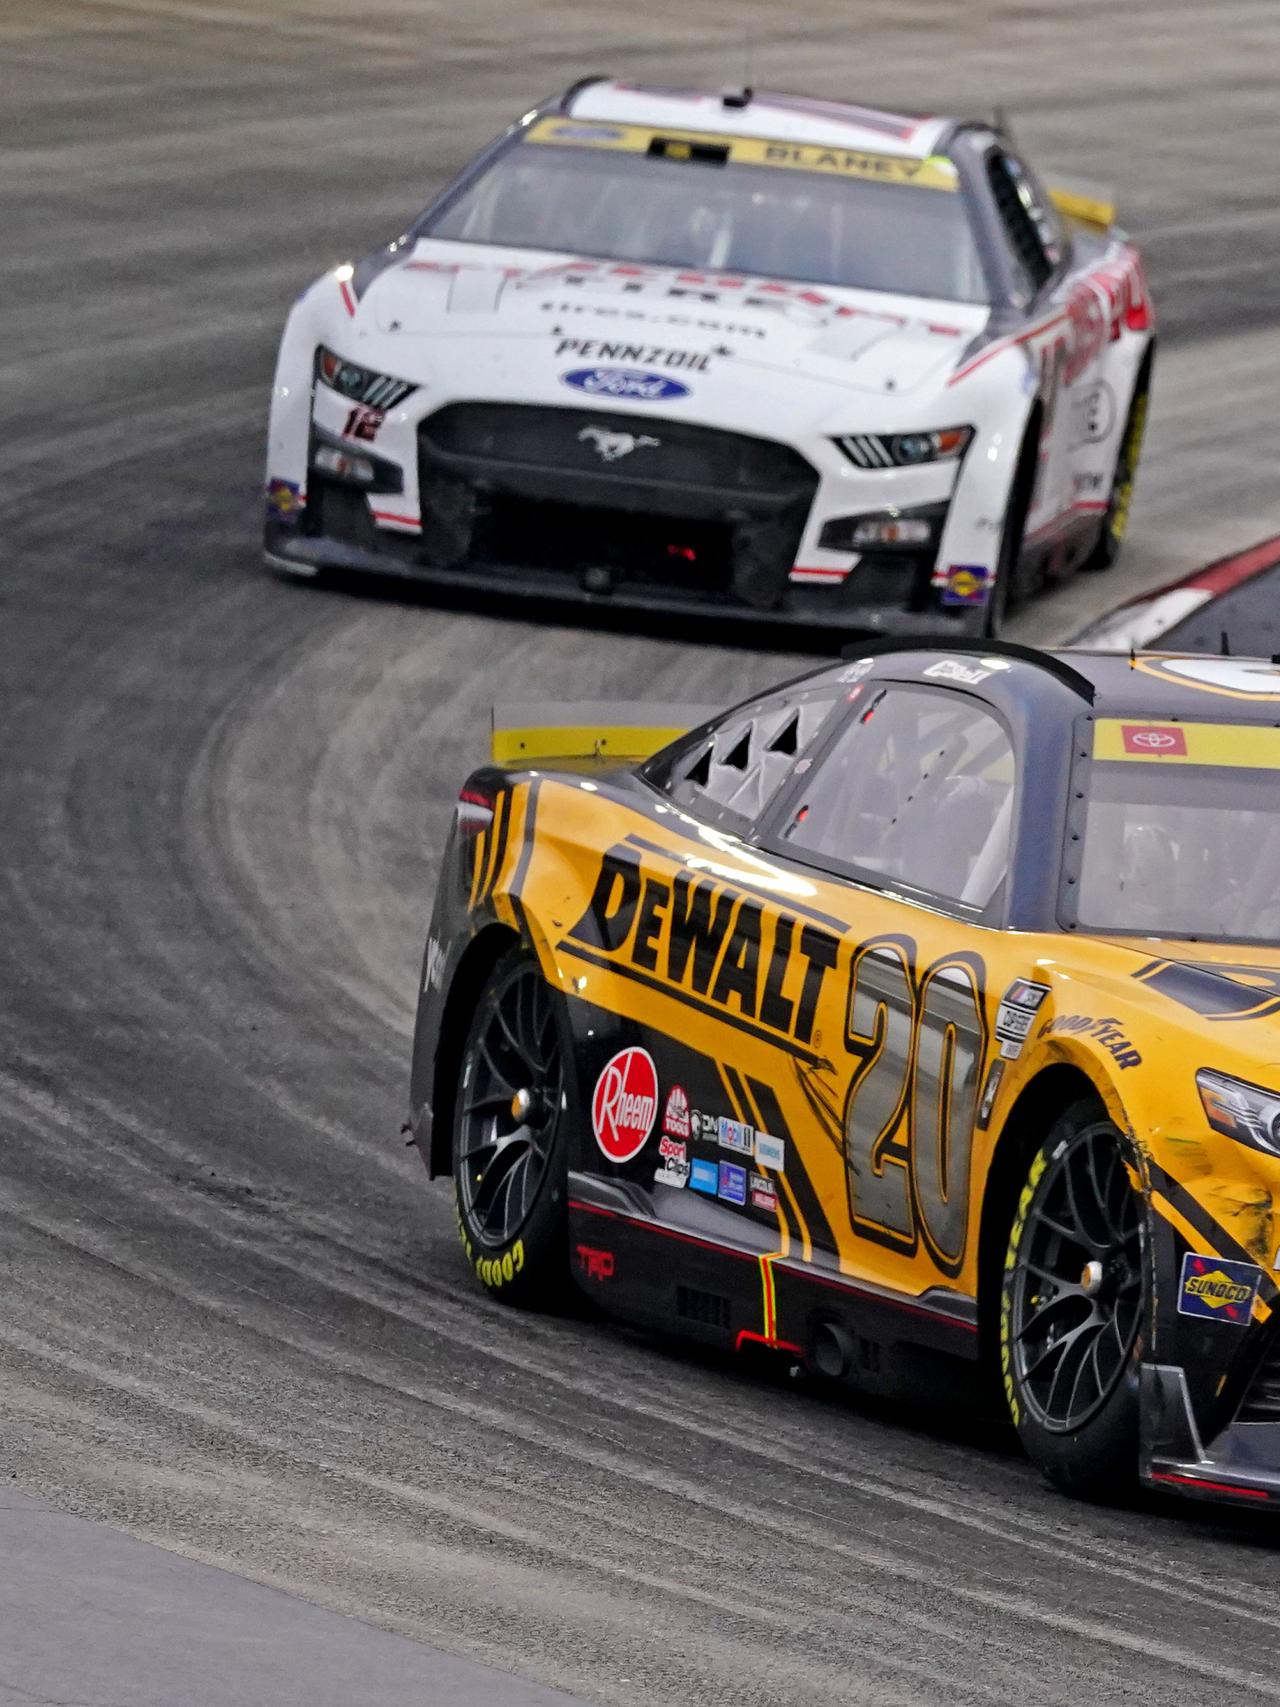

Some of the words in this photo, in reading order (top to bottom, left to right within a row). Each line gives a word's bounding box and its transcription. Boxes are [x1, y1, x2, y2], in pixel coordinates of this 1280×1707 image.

[764, 144, 923, 178] BLANEY
[555, 337, 712, 376] PENNZOIL
[598, 1050, 654, 1142] Rheem
[844, 934, 986, 1278] 20
[1186, 1278, 1250, 1301] SUNOCO
